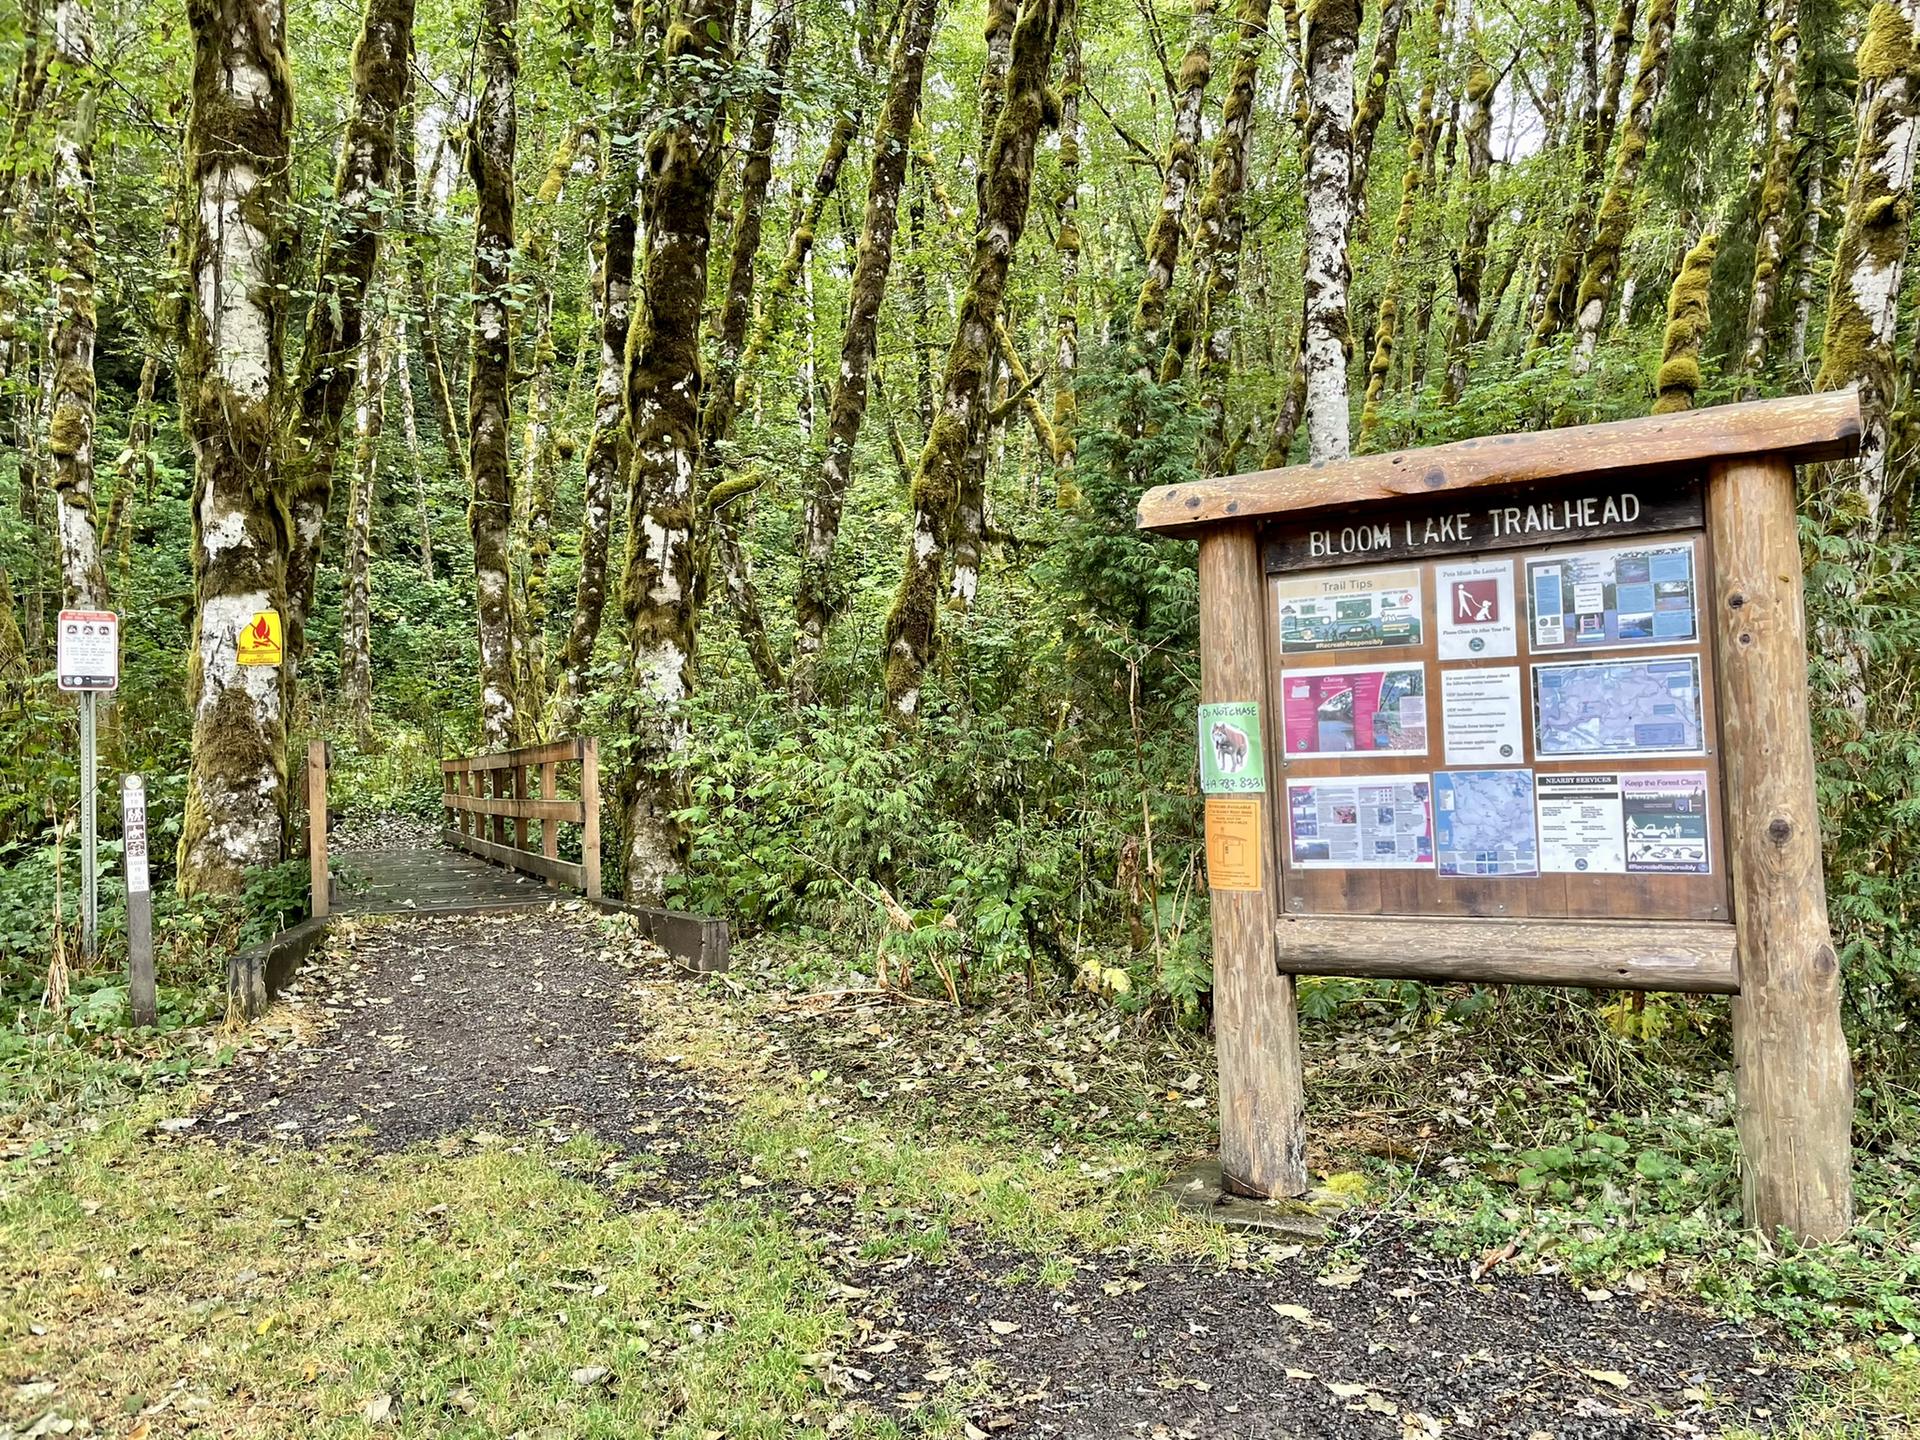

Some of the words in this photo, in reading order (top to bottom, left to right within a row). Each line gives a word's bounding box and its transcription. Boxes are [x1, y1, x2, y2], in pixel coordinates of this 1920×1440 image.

[1310, 523, 1392, 557] BLOOM
[1406, 513, 1474, 547] LAKE
[1487, 493, 1640, 538] TRAILHEAD
[1322, 580, 1346, 592] Trail
[1350, 580, 1373, 590] Tips
[1546, 776, 1574, 784] NEARBY
[1624, 779, 1644, 788] Keep
[1644, 779, 1656, 787] the
